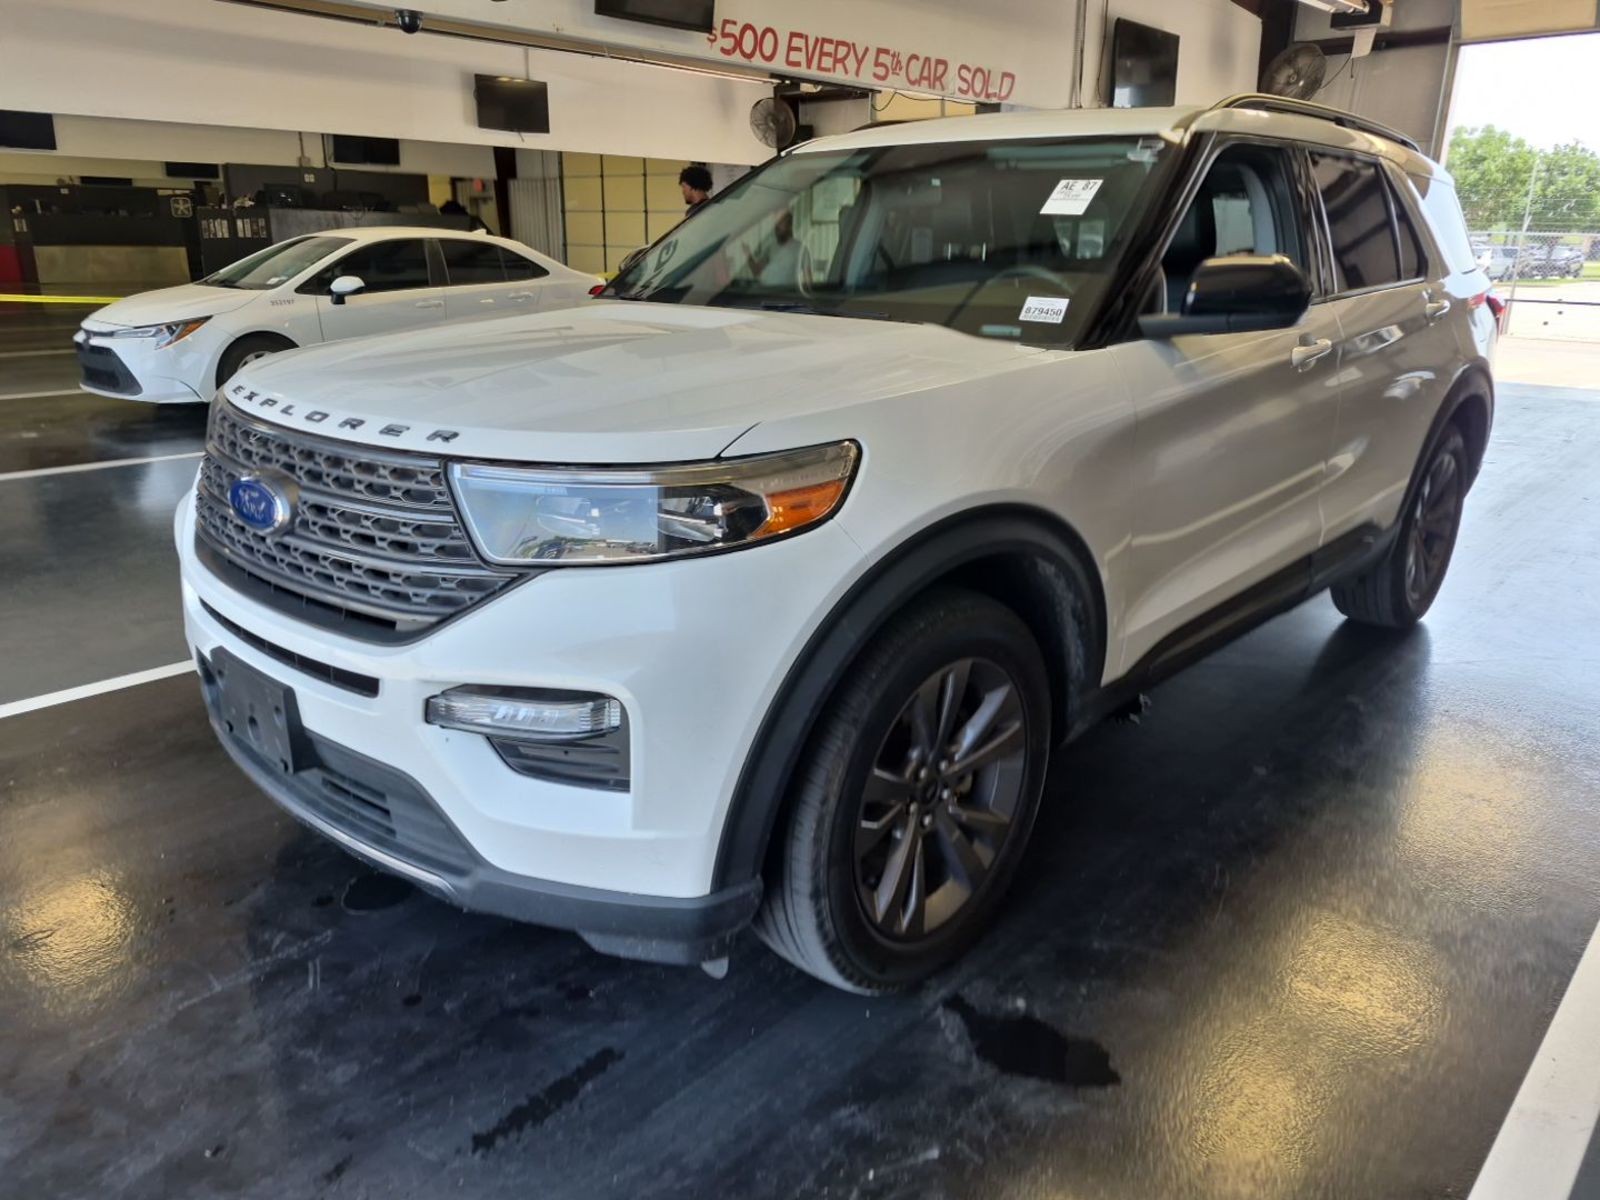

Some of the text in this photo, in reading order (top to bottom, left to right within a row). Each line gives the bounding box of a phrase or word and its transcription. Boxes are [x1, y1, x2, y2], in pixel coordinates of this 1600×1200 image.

[706, 18, 1016, 102] $500 EVERY 5th CAR SOLD
[1061, 181, 1098, 191] AE 87
[1025, 306, 1063, 317] 879450
[231, 384, 460, 443] EXPLORER
[234, 486, 266, 521] Ford
